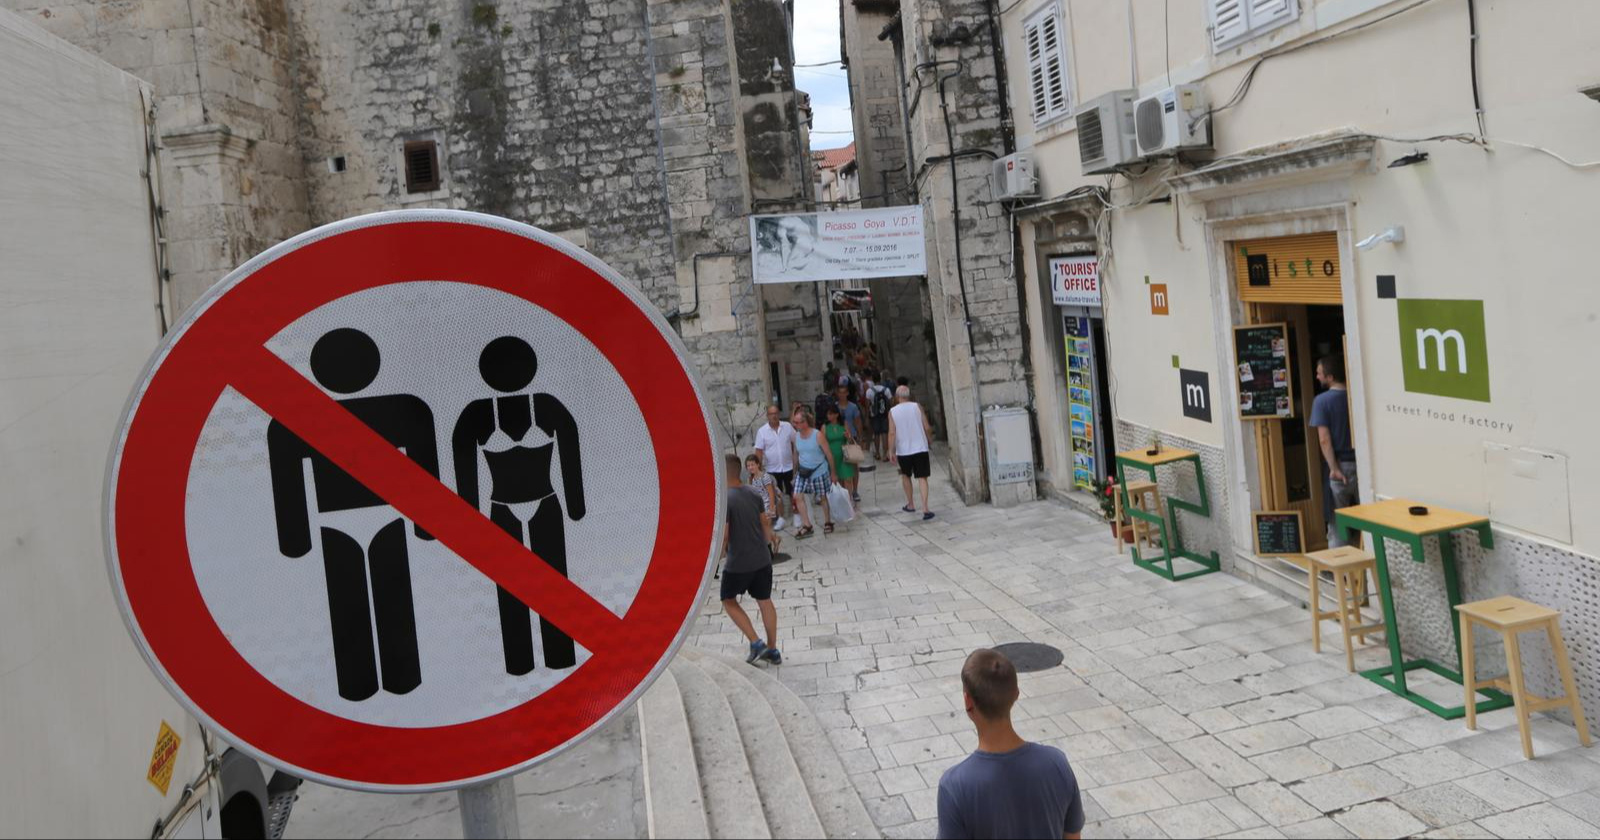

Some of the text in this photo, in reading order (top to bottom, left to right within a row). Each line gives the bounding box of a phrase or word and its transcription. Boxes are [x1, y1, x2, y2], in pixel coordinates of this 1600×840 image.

[824, 221, 857, 231] Picasso
[863, 218, 886, 230] Goya
[865, 244, 897, 253] 15.09.2016
[1059, 262, 1098, 276] TOURIST
[1251, 257, 1334, 279] misto
[1064, 278, 1096, 291] OFFICE
[1154, 291, 1166, 307] m
[1416, 327, 1468, 374] m
[1186, 383, 1205, 409] m
[1386, 404, 1514, 432] street food factory
